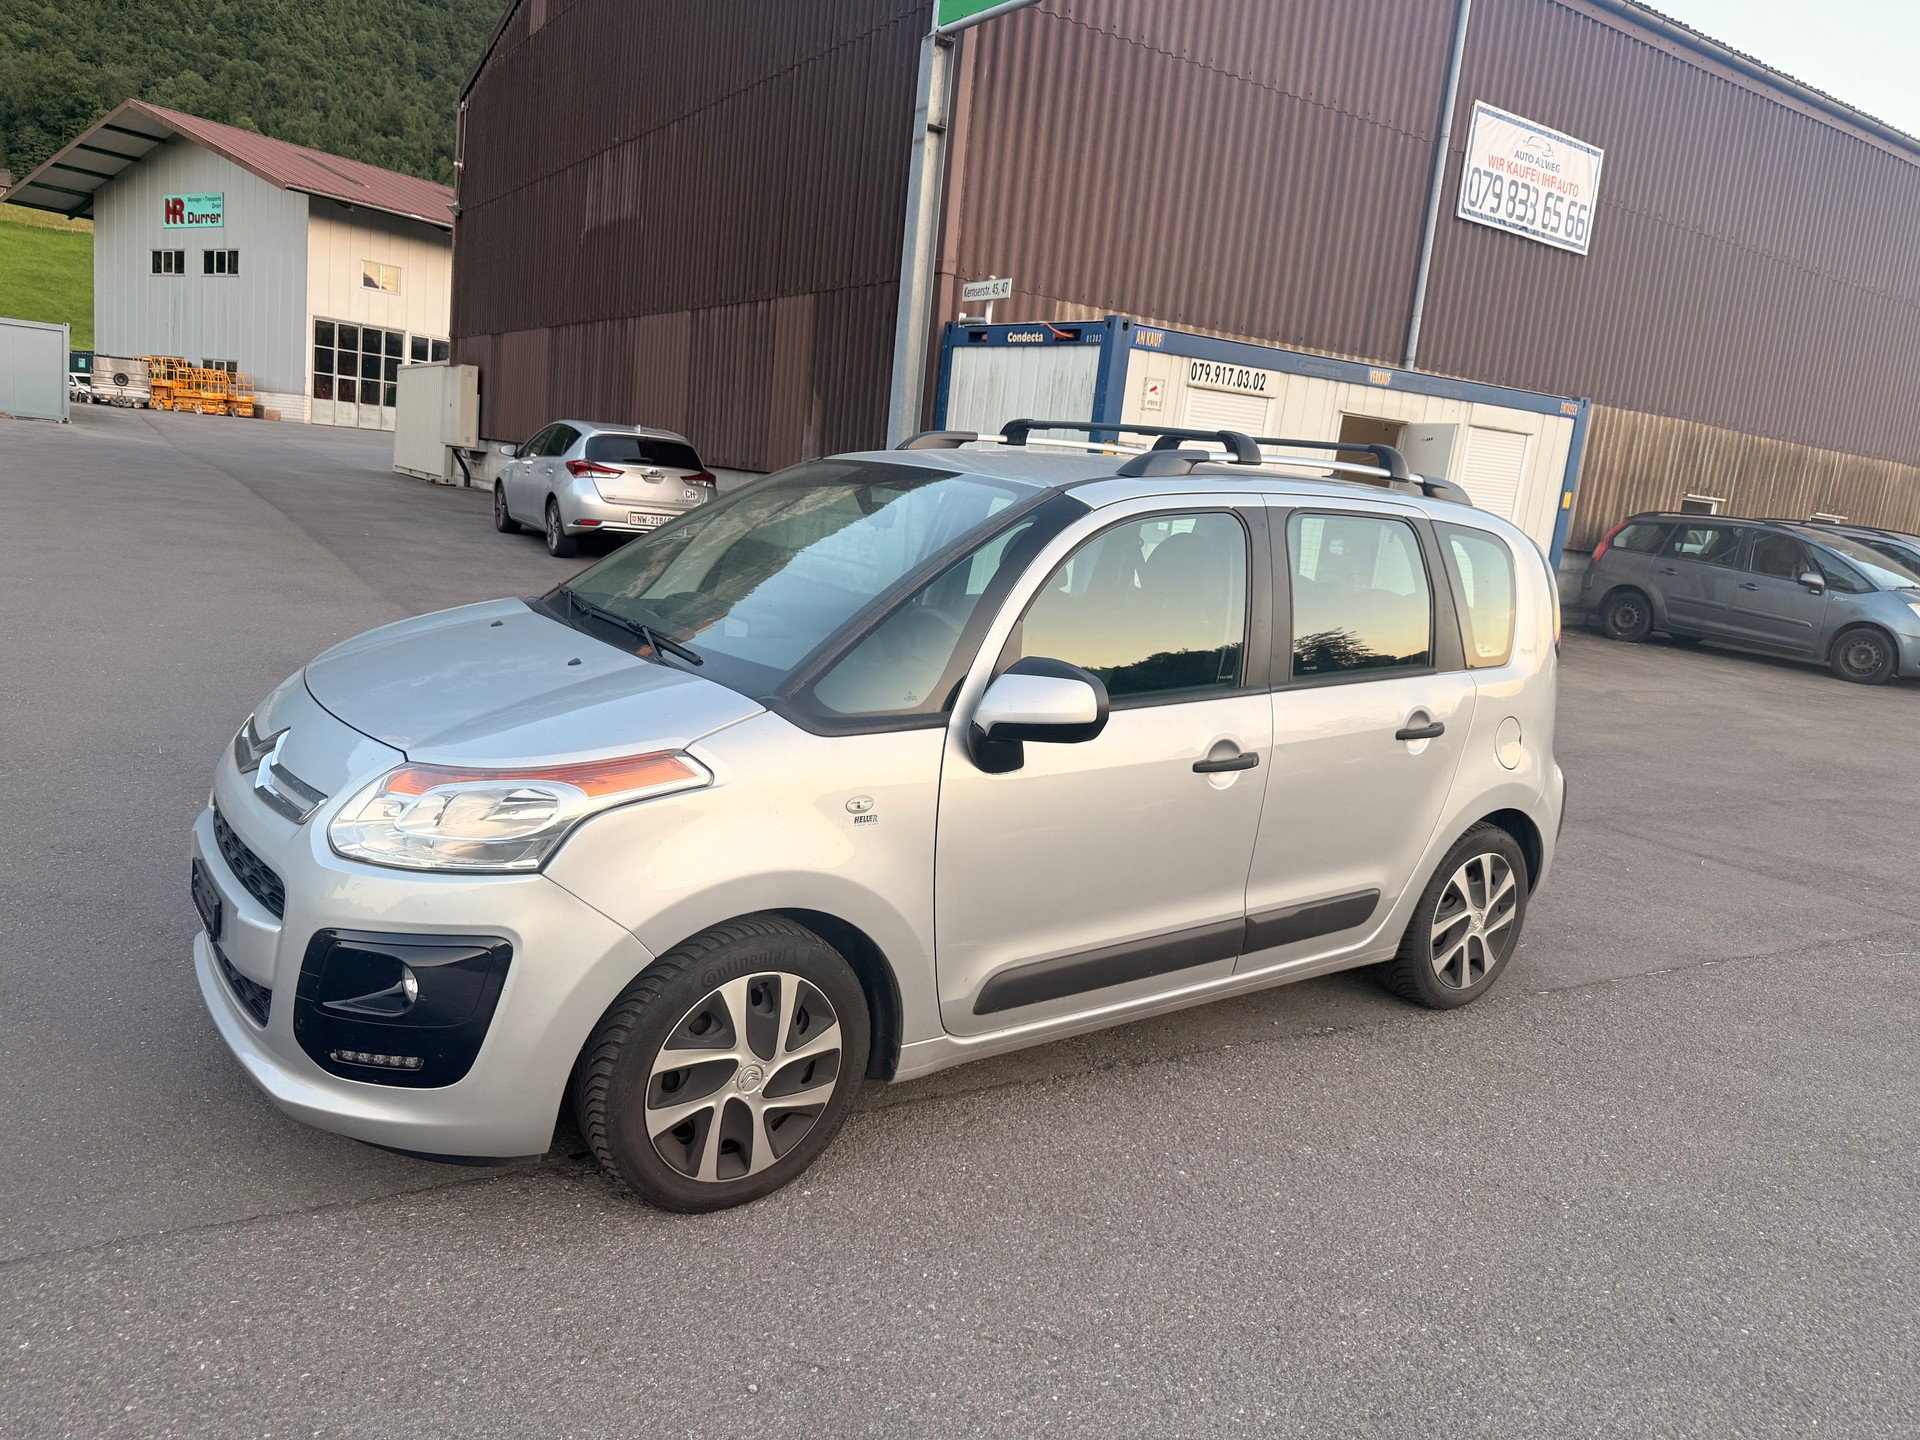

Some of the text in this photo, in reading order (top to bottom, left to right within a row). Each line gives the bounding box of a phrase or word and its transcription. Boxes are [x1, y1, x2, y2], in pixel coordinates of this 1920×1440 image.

[1488, 154, 1504, 171] WIR
[1514, 150, 1534, 163] AUTO
[1468, 167, 1588, 241] 079 833 65 66
[187, 211, 222, 224] Durrer
[1001, 282, 1009, 294] 47
[1007, 331, 1044, 343] Condecta
[1190, 361, 1267, 392] 079.917.03.02
[685, 490, 695, 499] CH
[853, 815, 878, 824] HELLER
[701, 948, 786, 987] Continental
